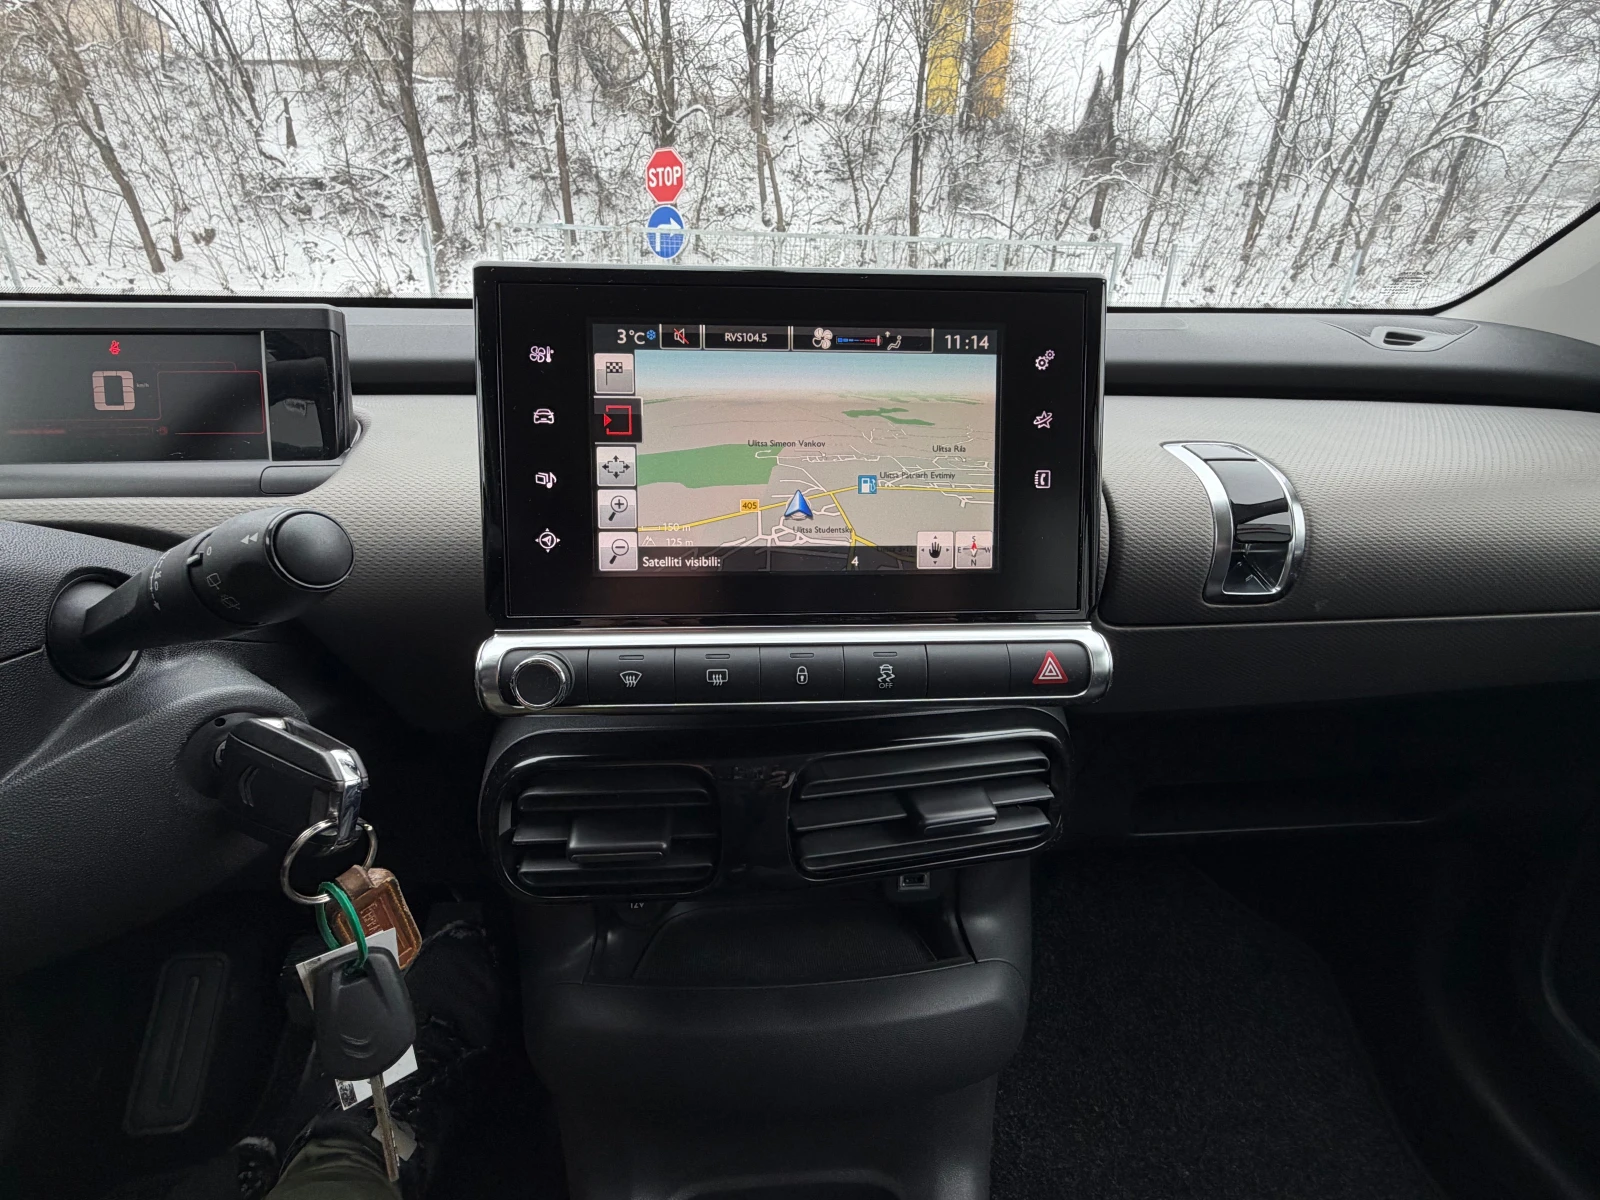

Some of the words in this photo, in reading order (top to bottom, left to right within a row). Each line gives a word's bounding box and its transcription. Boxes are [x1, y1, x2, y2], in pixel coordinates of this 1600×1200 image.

[648, 166, 682, 188] STOP
[724, 332, 768, 343] RVS104.5
[944, 334, 990, 350] 11:14
[747, 439, 768, 448] Ulitsa
[769, 439, 796, 448] Simeon
[798, 439, 826, 448] Vankov
[932, 444, 952, 453] Ulitsa
[953, 444, 967, 453] Rila
[879, 471, 900, 480] Ulitsa
[901, 471, 929, 480] Patriarh
[930, 471, 956, 481] Evtimiy
[742, 501, 758, 510] 405
[662, 522, 680, 532] 150
[792, 525, 813, 534] Ulitsa
[666, 538, 683, 547] 125
[642, 556, 682, 567] Satelliti
[685, 555, 721, 567] visibili:
[851, 556, 859, 566] 4
